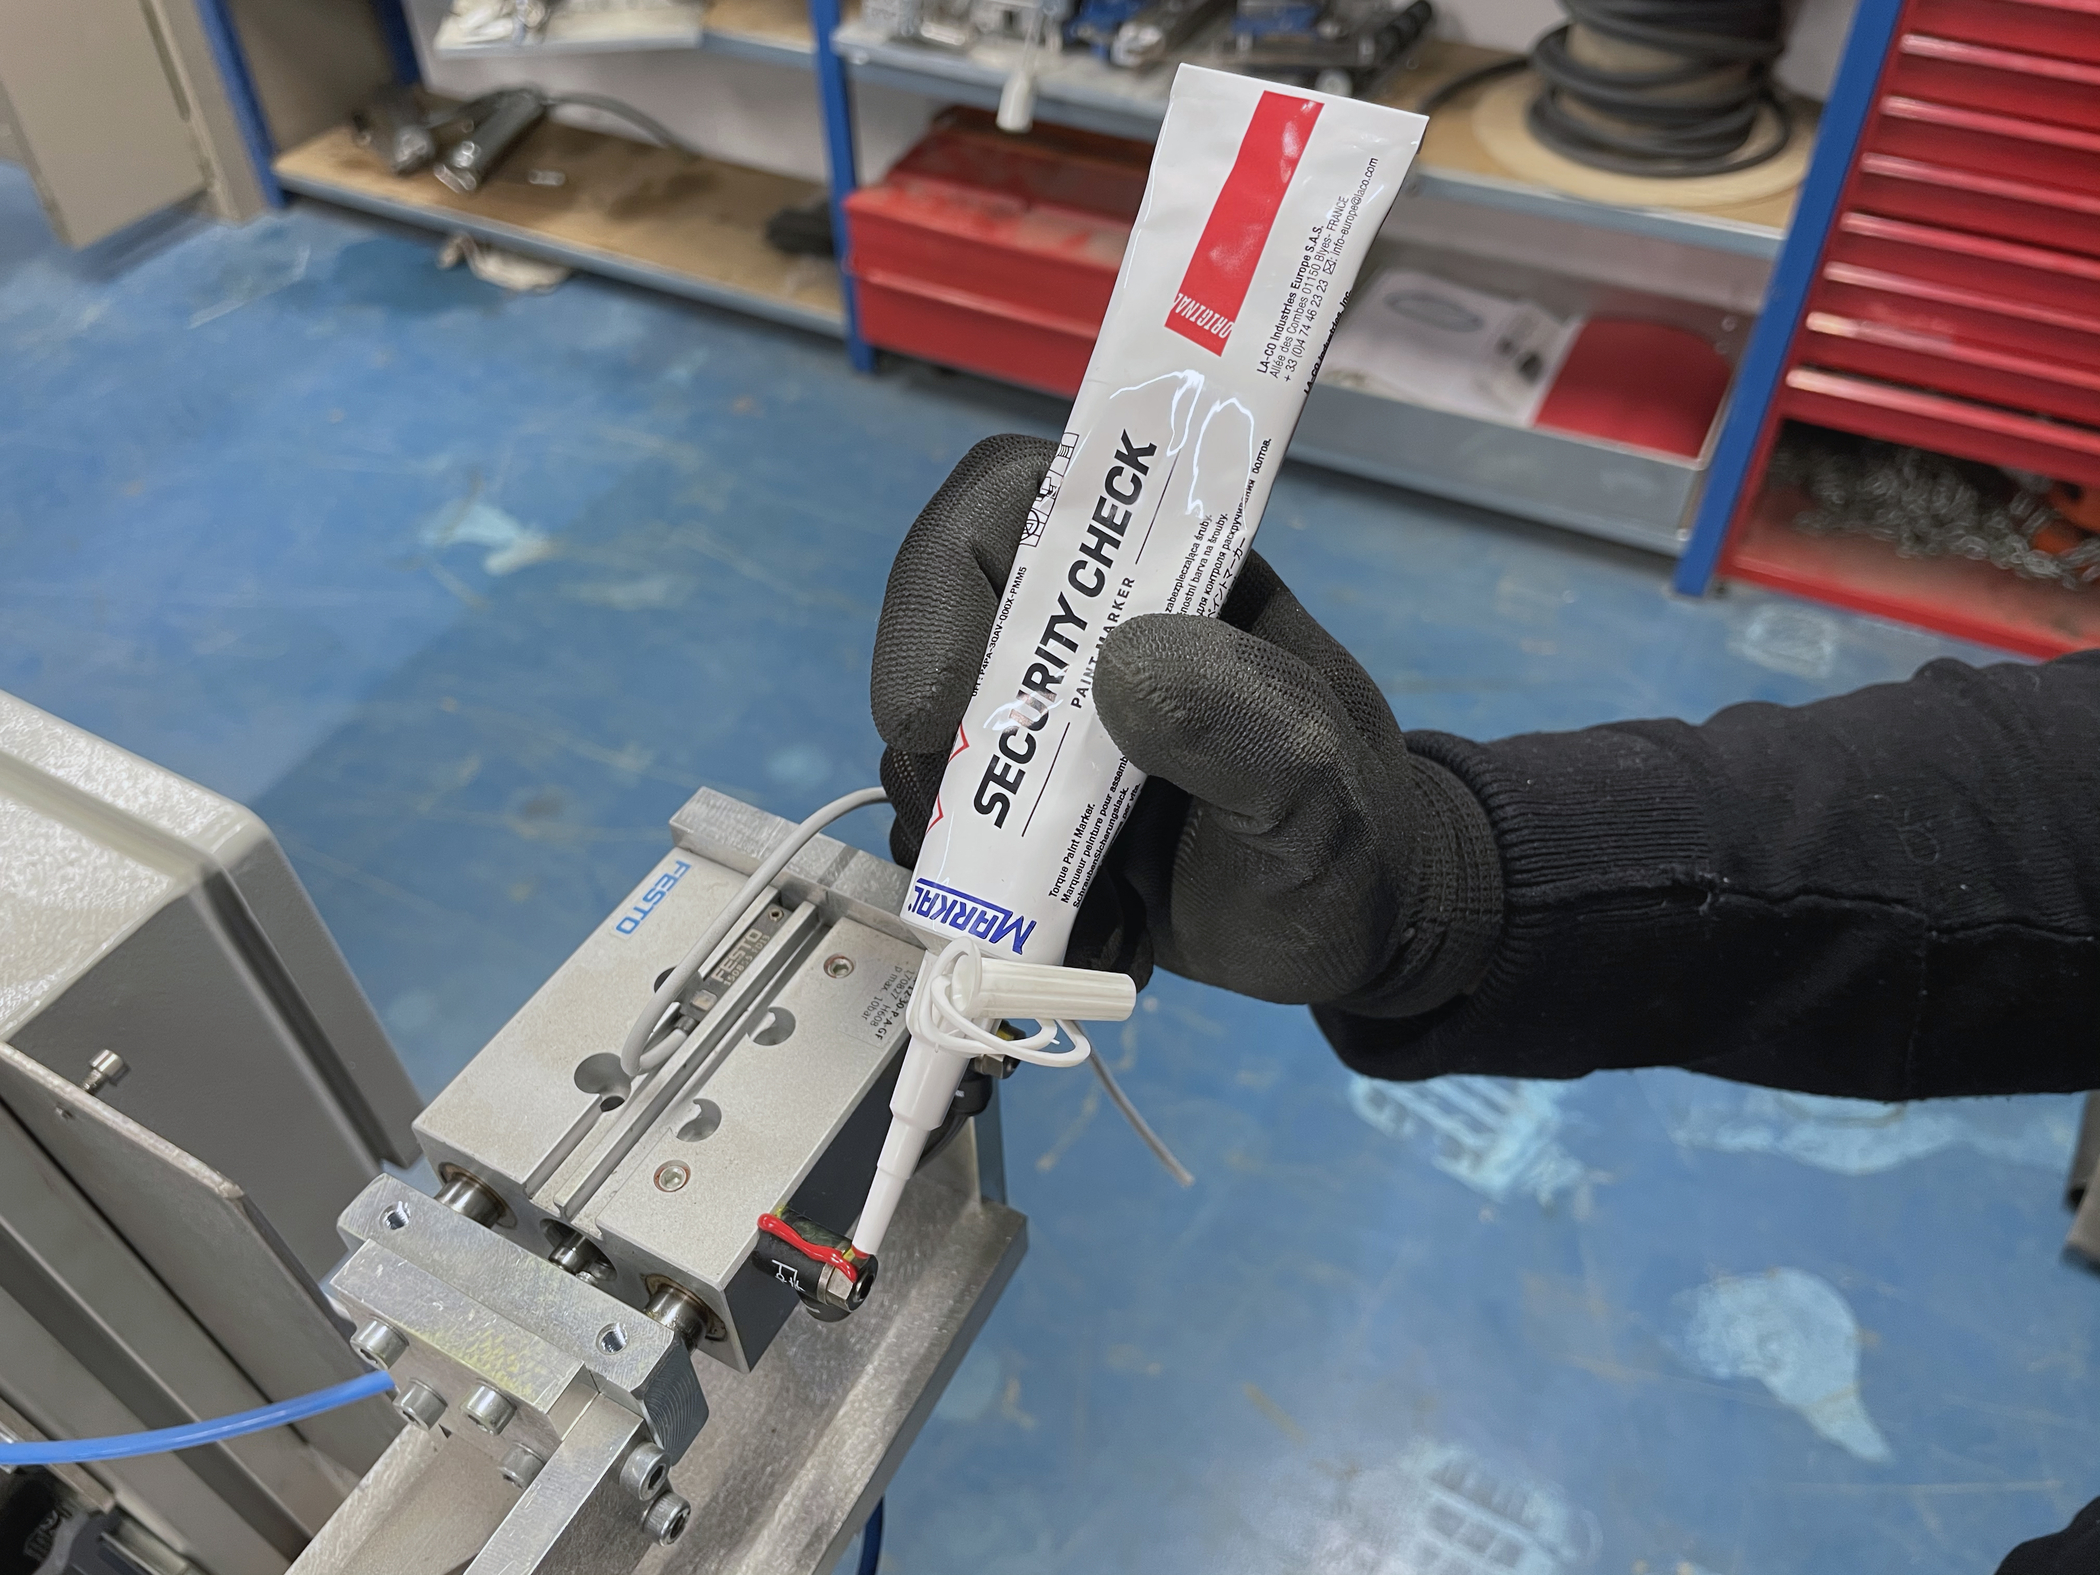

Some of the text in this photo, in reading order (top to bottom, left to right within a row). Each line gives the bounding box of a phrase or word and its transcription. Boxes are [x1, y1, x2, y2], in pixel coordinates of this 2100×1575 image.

[1326, 195, 1350, 232] FRANCE
[1302, 263, 1321, 295] 01150
[1316, 279, 1329, 293] 23
[1174, 292, 1235, 339] ORIGINAL
[1257, 225, 1324, 374] LA-CO Industries Europe S.A.S.
[1286, 296, 1309, 334] Combes
[1305, 309, 1318, 322] 46
[1311, 294, 1323, 308] 23
[1281, 336, 1293, 353] des
[1291, 338, 1306, 358] (0)4
[1299, 324, 1311, 337] 74
[1269, 354, 1286, 379] Allée
[1285, 358, 1298, 372] 33
[1179, 513, 1228, 615] nostní barva na šrouby.
[1205, 552, 1226, 595] контроля
[974, 428, 1157, 829] SECURITY CHECK
[1071, 656, 1098, 708] PAINT
[1061, 857, 1087, 903] Marqueur
[1083, 817, 1103, 858] peinture
[1100, 793, 1113, 816] pour
[1109, 756, 1128, 793] assemb
[1048, 803, 1095, 897] Torque Paint Marker.
[615, 859, 692, 935] FESTO
[911, 877, 1037, 955] MARKAL
[711, 928, 763, 982] FESTO
